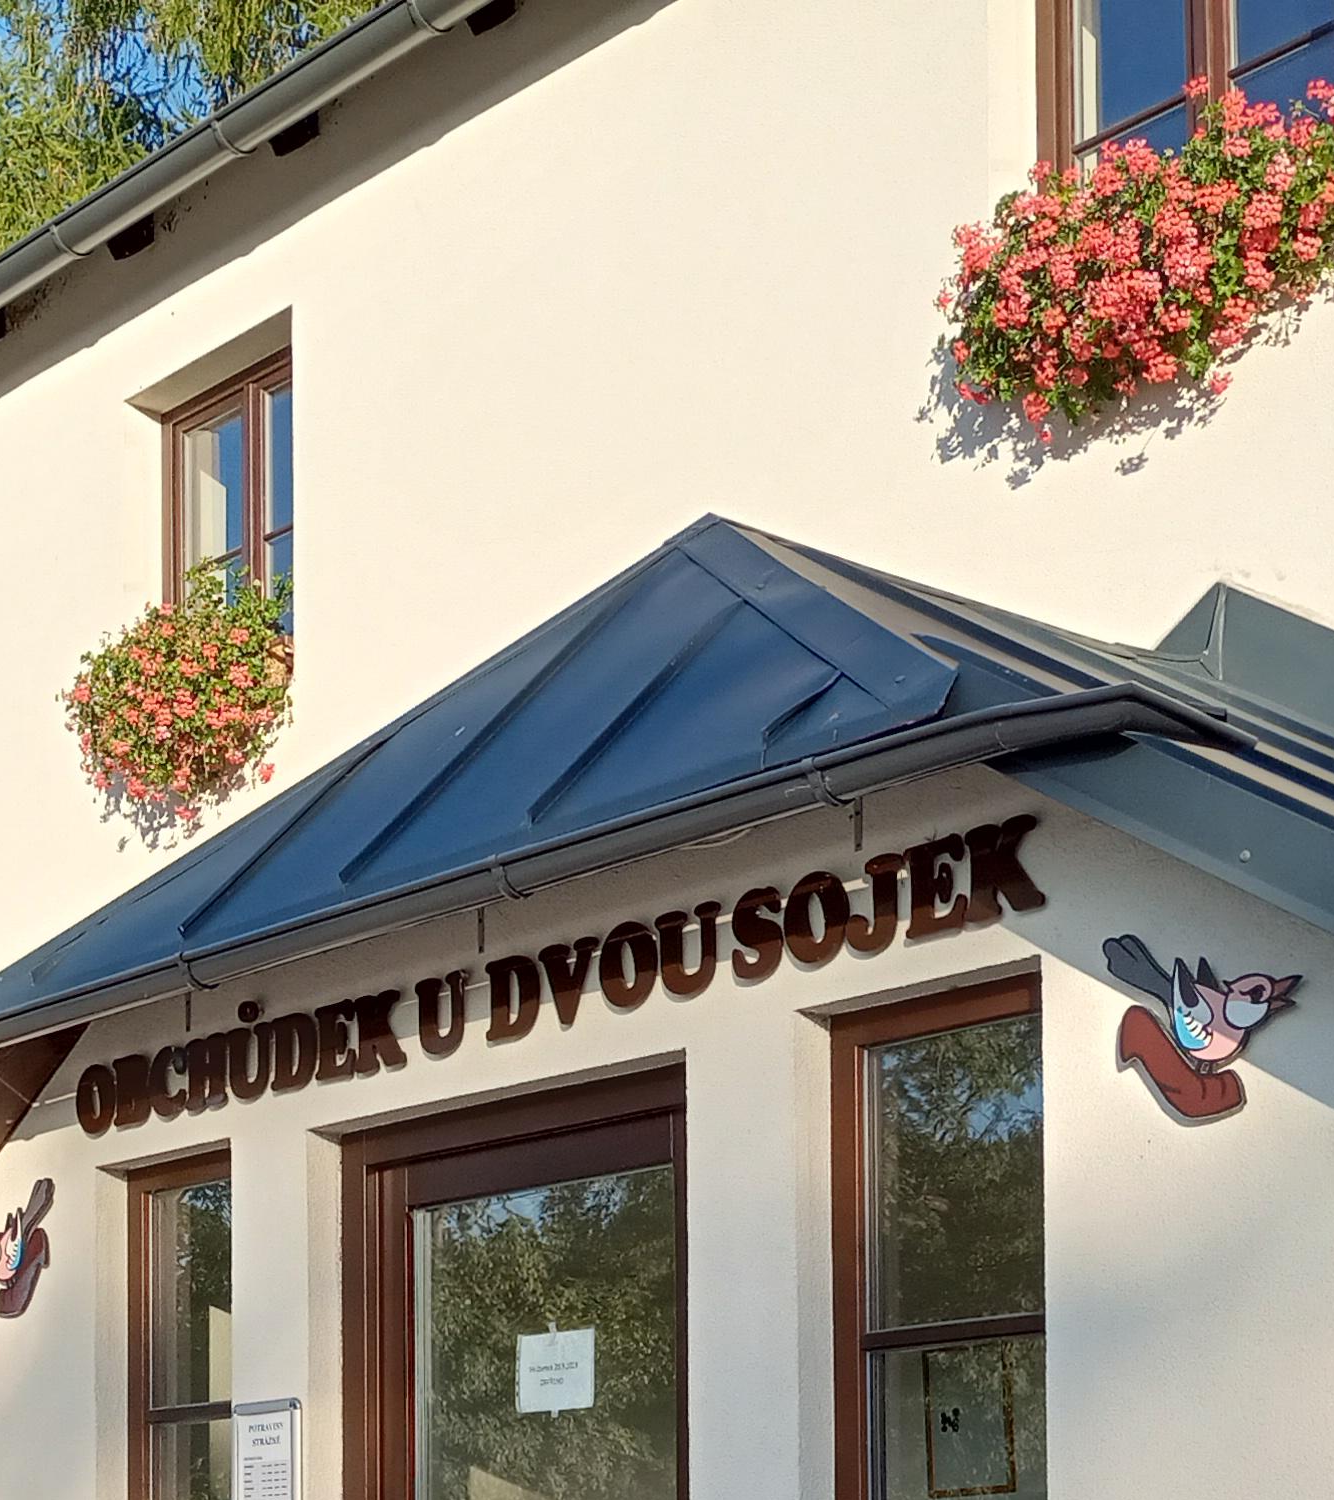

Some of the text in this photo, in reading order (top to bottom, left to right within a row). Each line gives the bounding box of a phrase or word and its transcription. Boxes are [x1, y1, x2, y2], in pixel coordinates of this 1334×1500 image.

[75, 813, 1047, 1138] OBCHŮDEK U DVOU SOJEK
